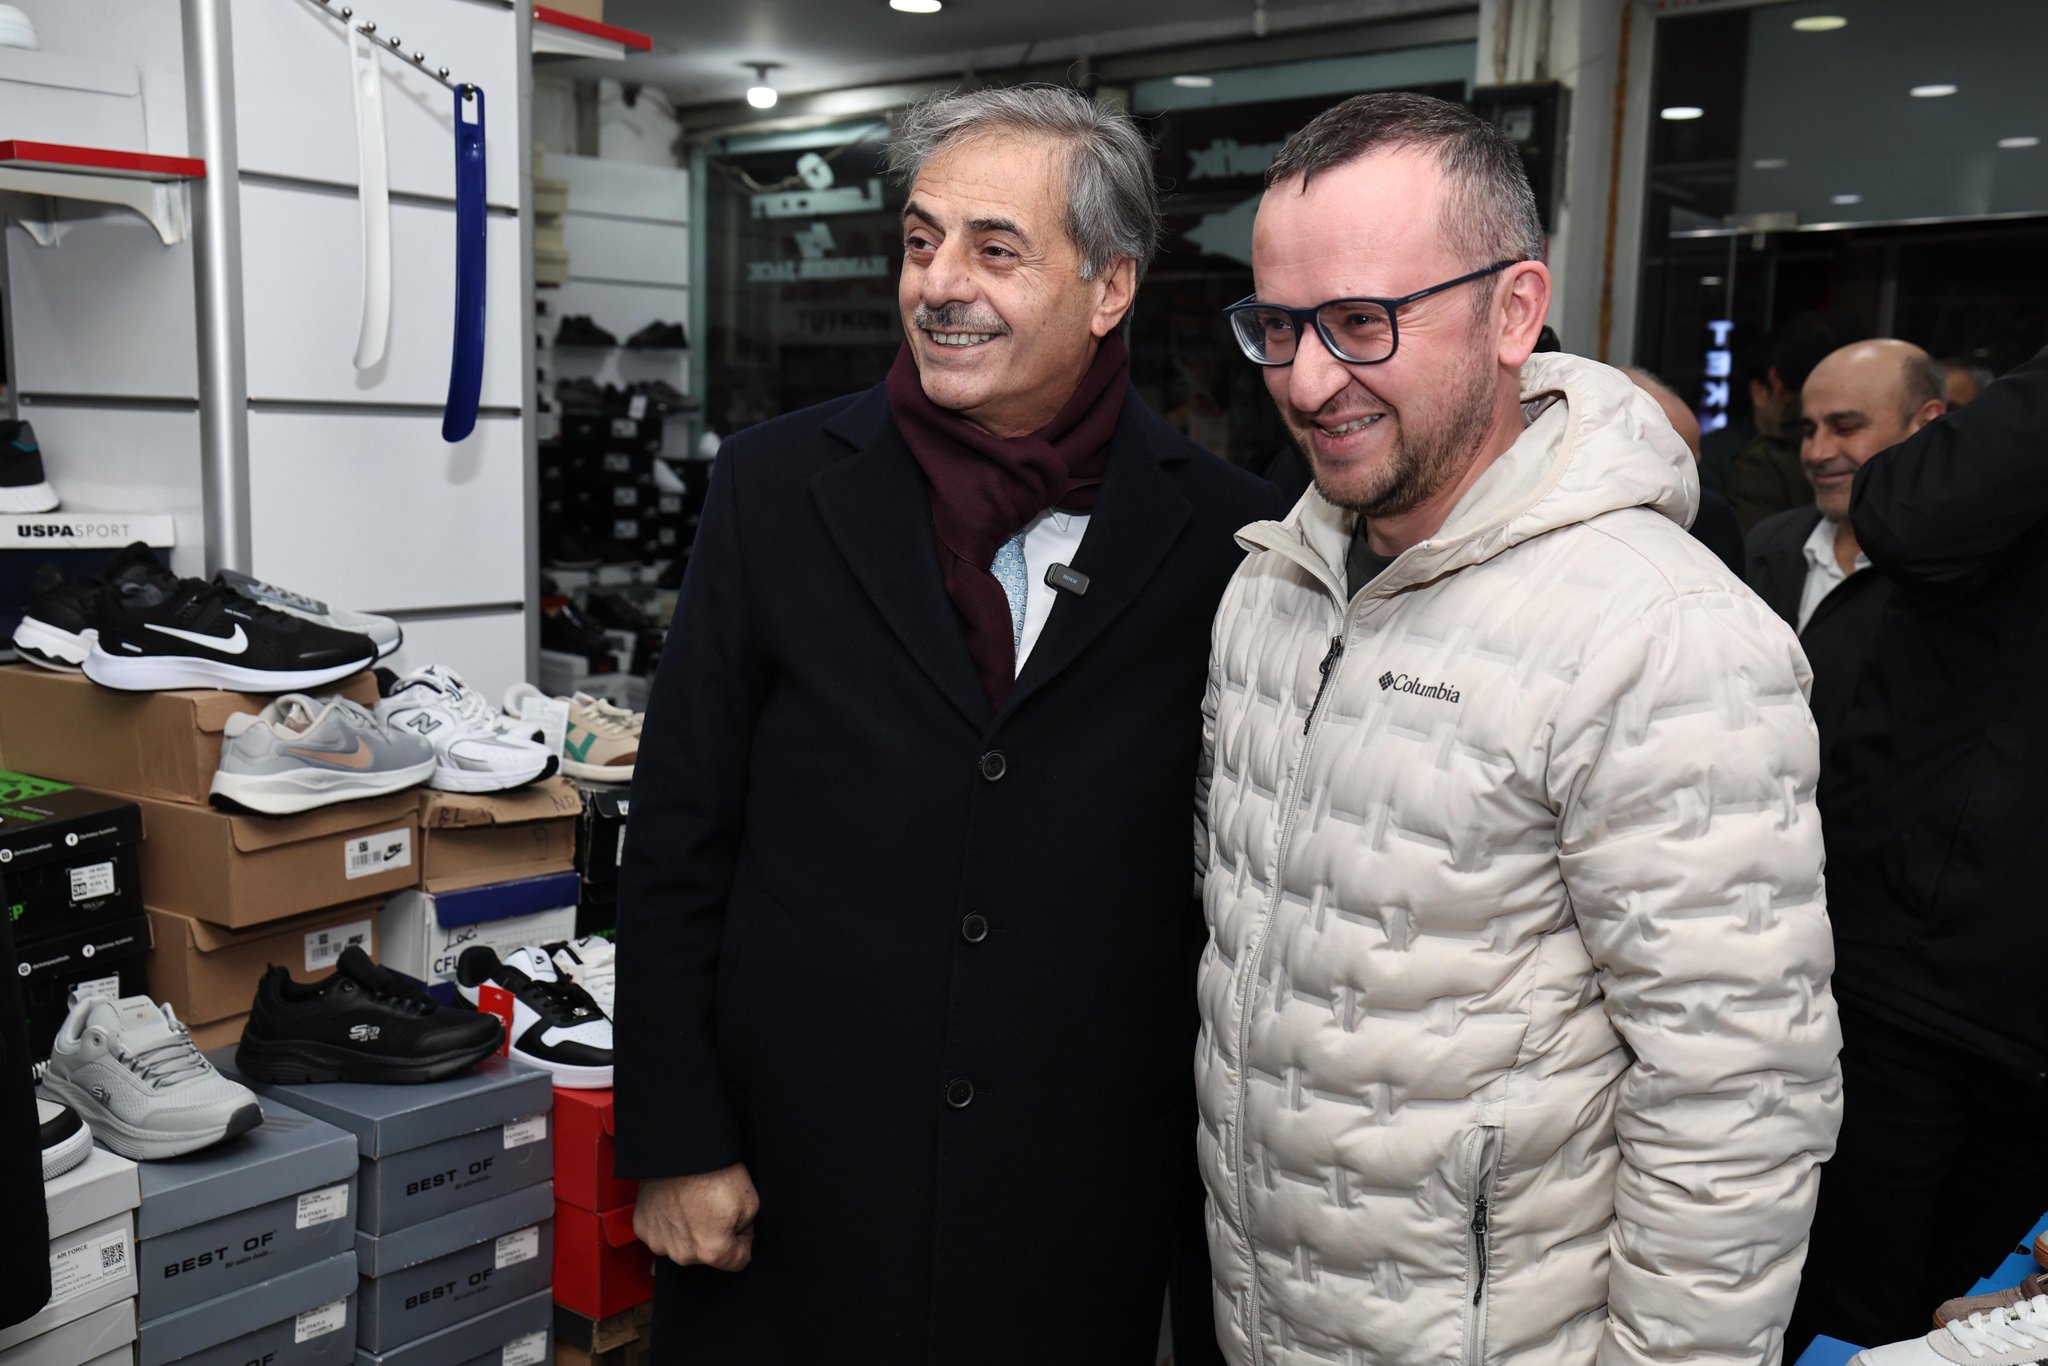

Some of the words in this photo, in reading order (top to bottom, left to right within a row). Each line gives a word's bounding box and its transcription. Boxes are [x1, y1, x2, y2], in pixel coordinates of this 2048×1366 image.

[1393, 673, 1461, 703] Columbia
[406, 1169, 457, 1196] BEST
[469, 1157, 494, 1175] OF
[56, 1252, 67, 1260] AIR
[67, 1244, 88, 1256] FORCE
[164, 1247, 229, 1278] BEST
[243, 1231, 275, 1252] OF
[405, 1281, 457, 1310] BEST
[468, 1268, 493, 1286] OF
